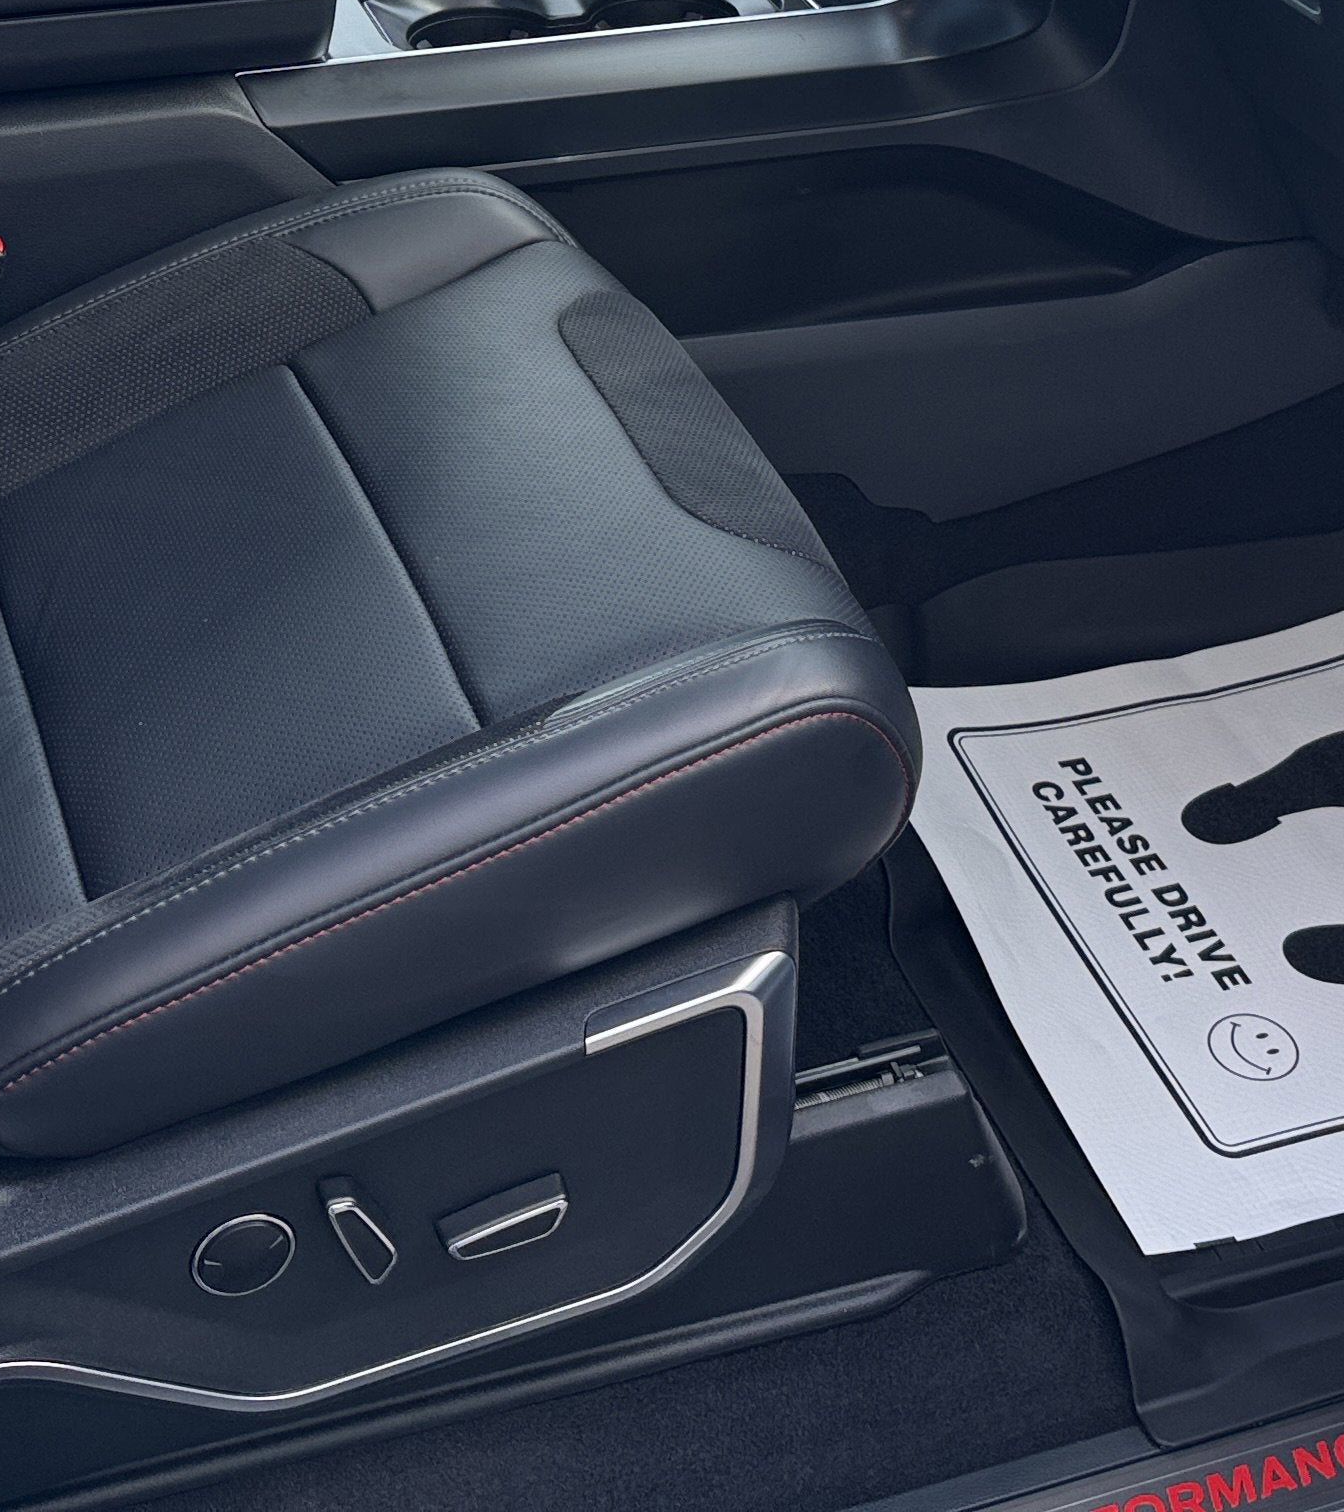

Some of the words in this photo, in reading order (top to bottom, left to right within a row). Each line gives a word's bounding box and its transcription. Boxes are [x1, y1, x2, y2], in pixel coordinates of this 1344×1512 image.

[1032, 780, 1195, 983] CAREFULLY!
[1058, 757, 1169, 876] PLEASE
[1151, 882, 1253, 991] DRIVE
